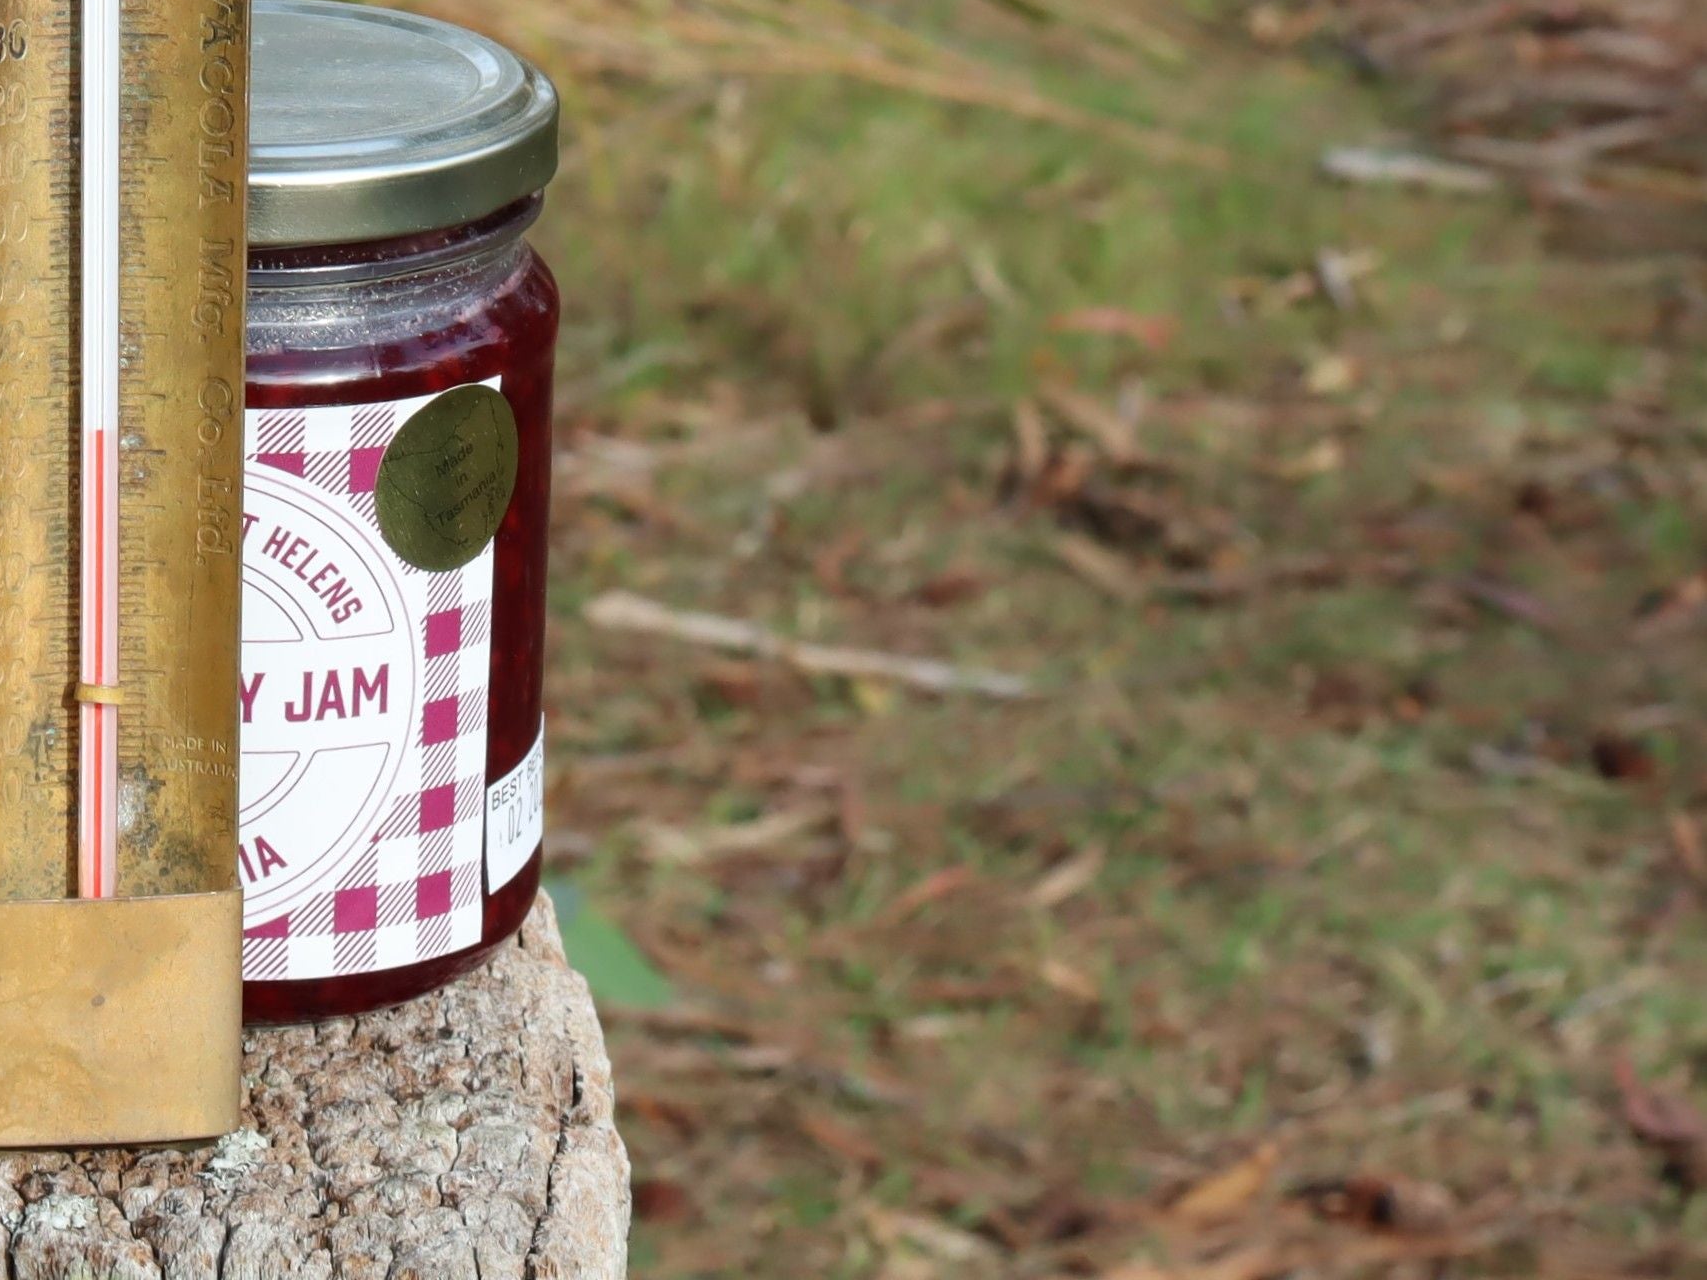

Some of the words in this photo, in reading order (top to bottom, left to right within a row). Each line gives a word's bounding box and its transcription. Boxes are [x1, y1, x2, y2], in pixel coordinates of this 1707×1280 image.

[435, 443, 474, 478] Made
[436, 471, 496, 526] Tasmania
[261, 526, 363, 624] HELENS
[285, 663, 389, 723] JAM
[211, 738, 228, 754] IN
[492, 769, 524, 811] BEST
